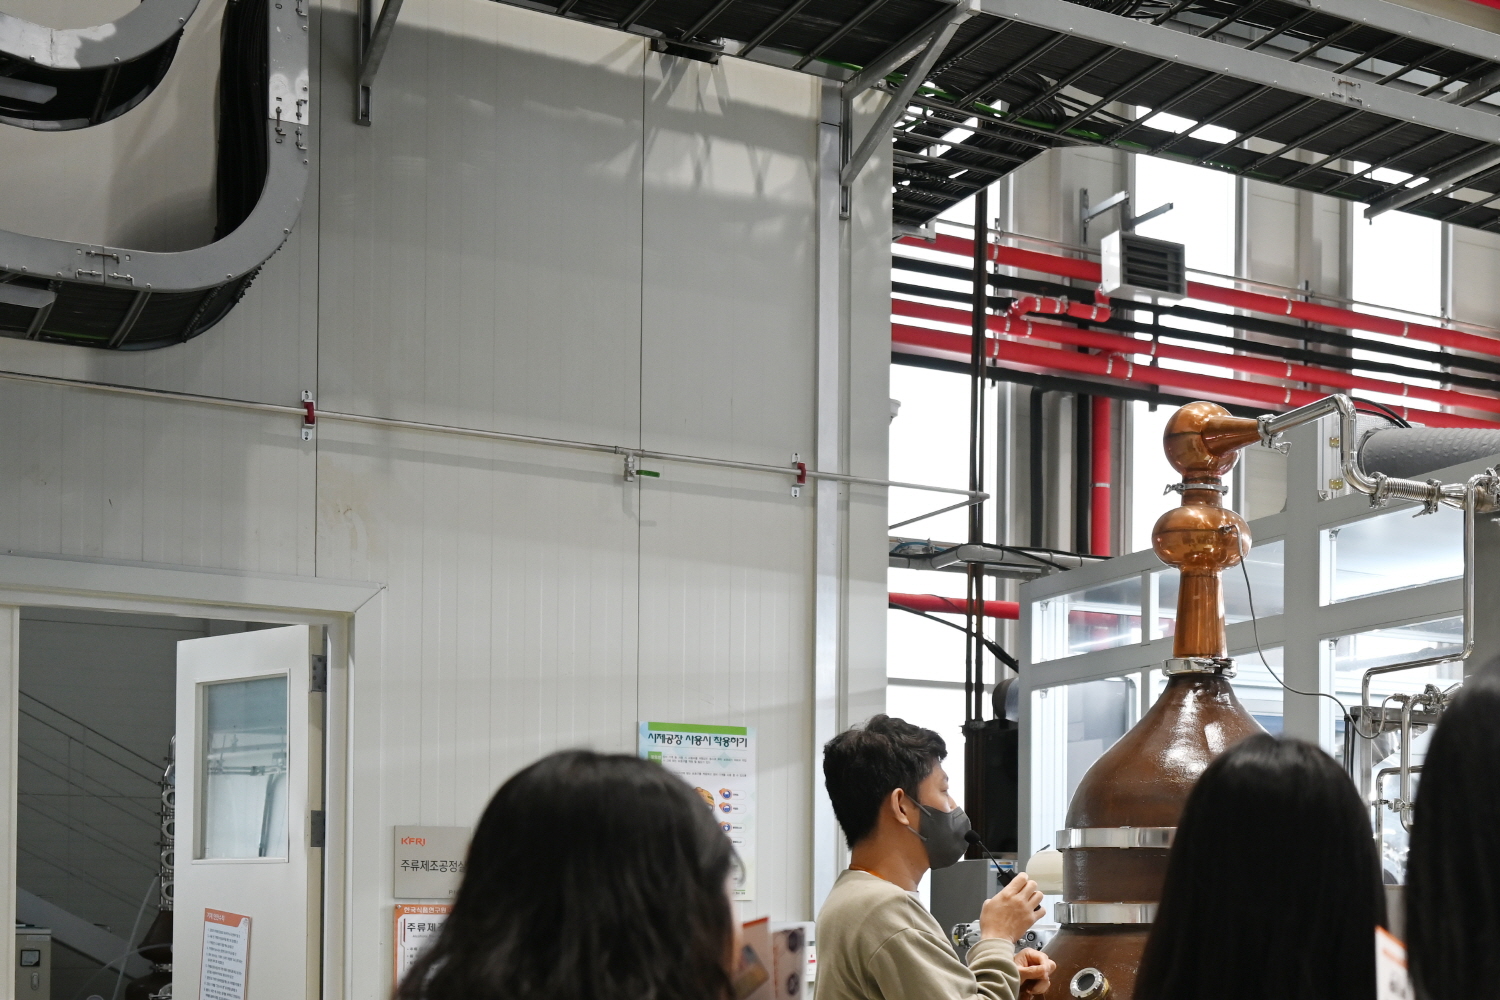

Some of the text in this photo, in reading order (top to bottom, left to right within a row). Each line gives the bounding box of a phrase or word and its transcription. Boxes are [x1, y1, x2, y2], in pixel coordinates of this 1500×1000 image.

[648, 732, 748, 748] 시제공장 사용시 착용하기
[401, 836, 426, 846] KFRI
[403, 906, 447, 914] 한국식품연구원
